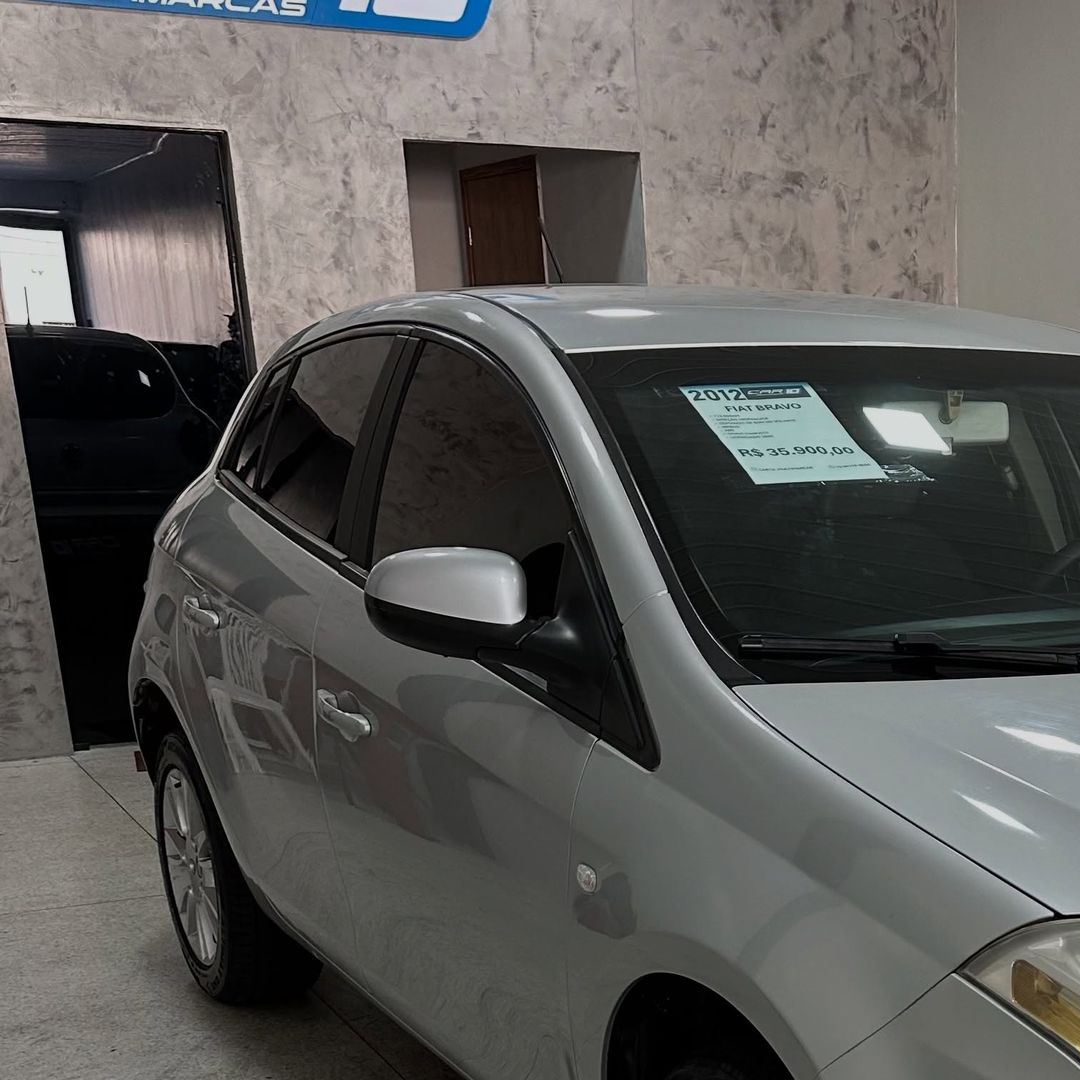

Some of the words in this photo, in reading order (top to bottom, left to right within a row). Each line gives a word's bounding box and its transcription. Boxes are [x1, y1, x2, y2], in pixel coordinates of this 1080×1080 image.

[688, 389, 746, 401] 2012
[725, 404, 754, 412] FIAT
[756, 402, 802, 412] BRAVO
[737, 448, 764, 458] R$
[766, 445, 855, 456] 35.900,00
